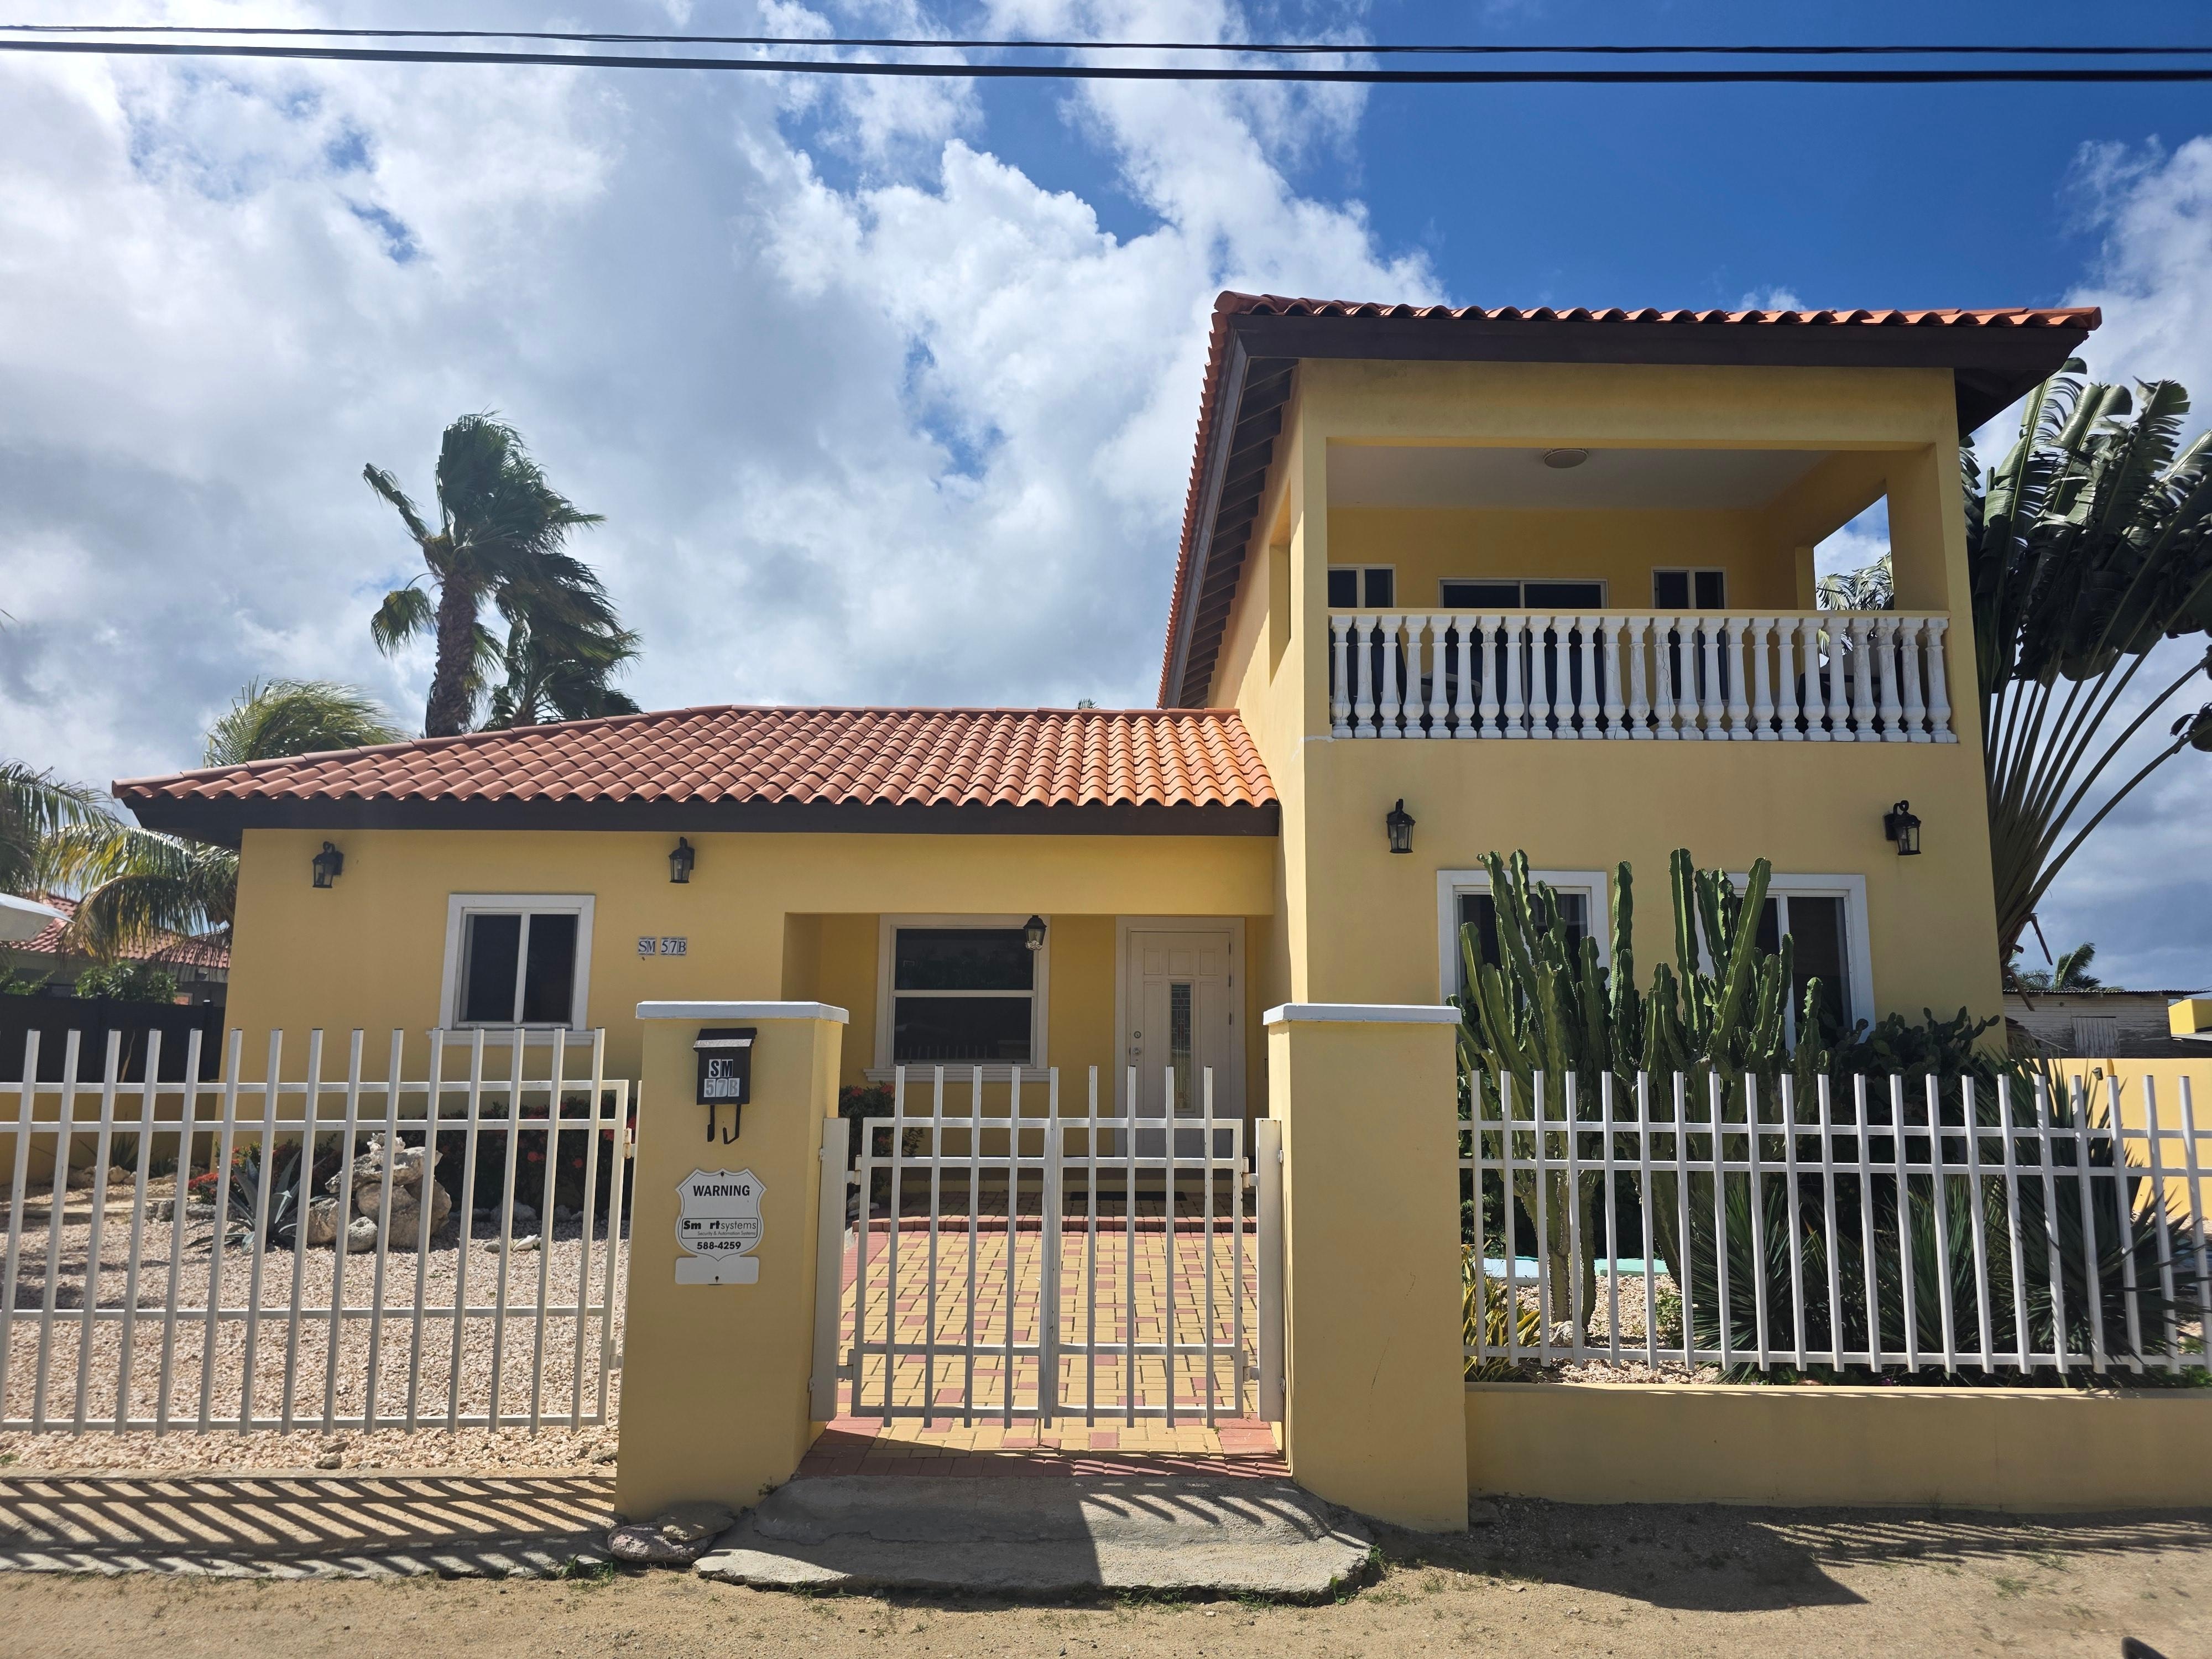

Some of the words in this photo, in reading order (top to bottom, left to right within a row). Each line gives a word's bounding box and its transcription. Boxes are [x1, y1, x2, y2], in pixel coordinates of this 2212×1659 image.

[638, 941, 655, 952] SM
[661, 940, 686, 953] 57B
[711, 1060, 733, 1077] SM
[706, 1079, 738, 1096] 57B
[693, 1185, 750, 1196] WARNING
